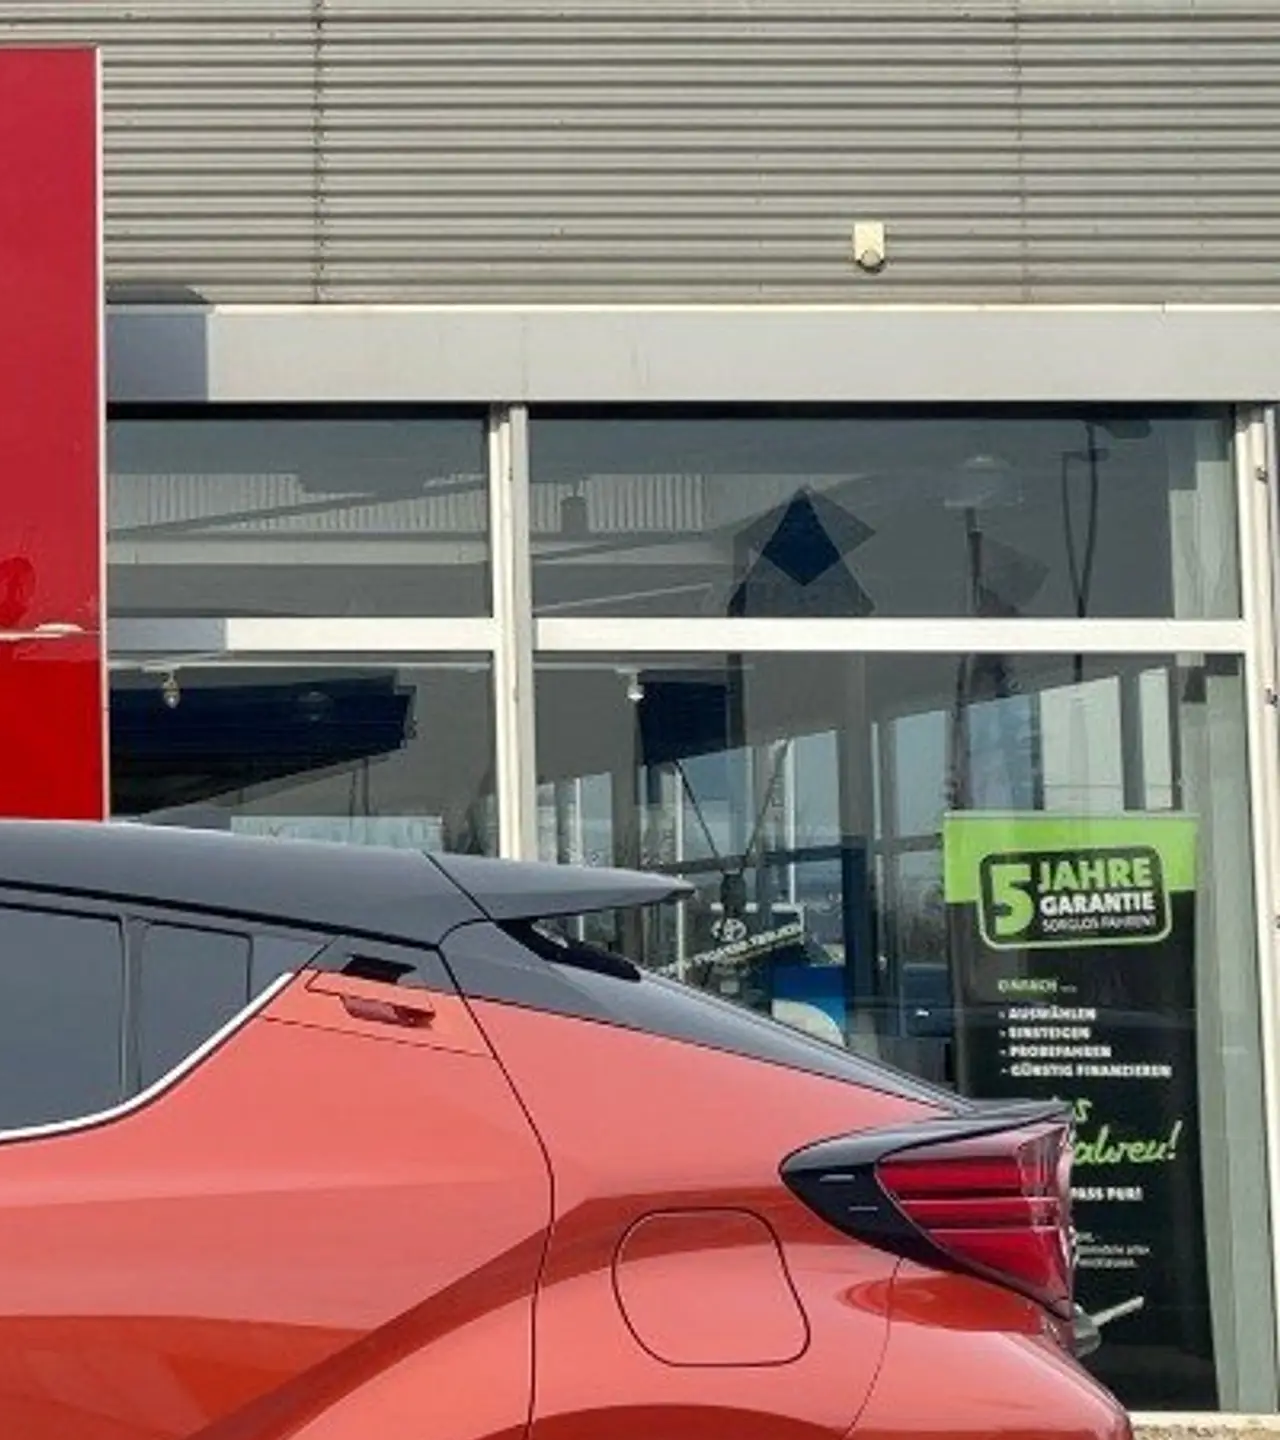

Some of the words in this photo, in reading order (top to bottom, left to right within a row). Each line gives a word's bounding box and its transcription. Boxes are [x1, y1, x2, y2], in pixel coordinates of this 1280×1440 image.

[1038, 857, 1153, 893] JAHRE
[991, 863, 1034, 936] 5
[1040, 891, 1156, 917] GARANTIE
